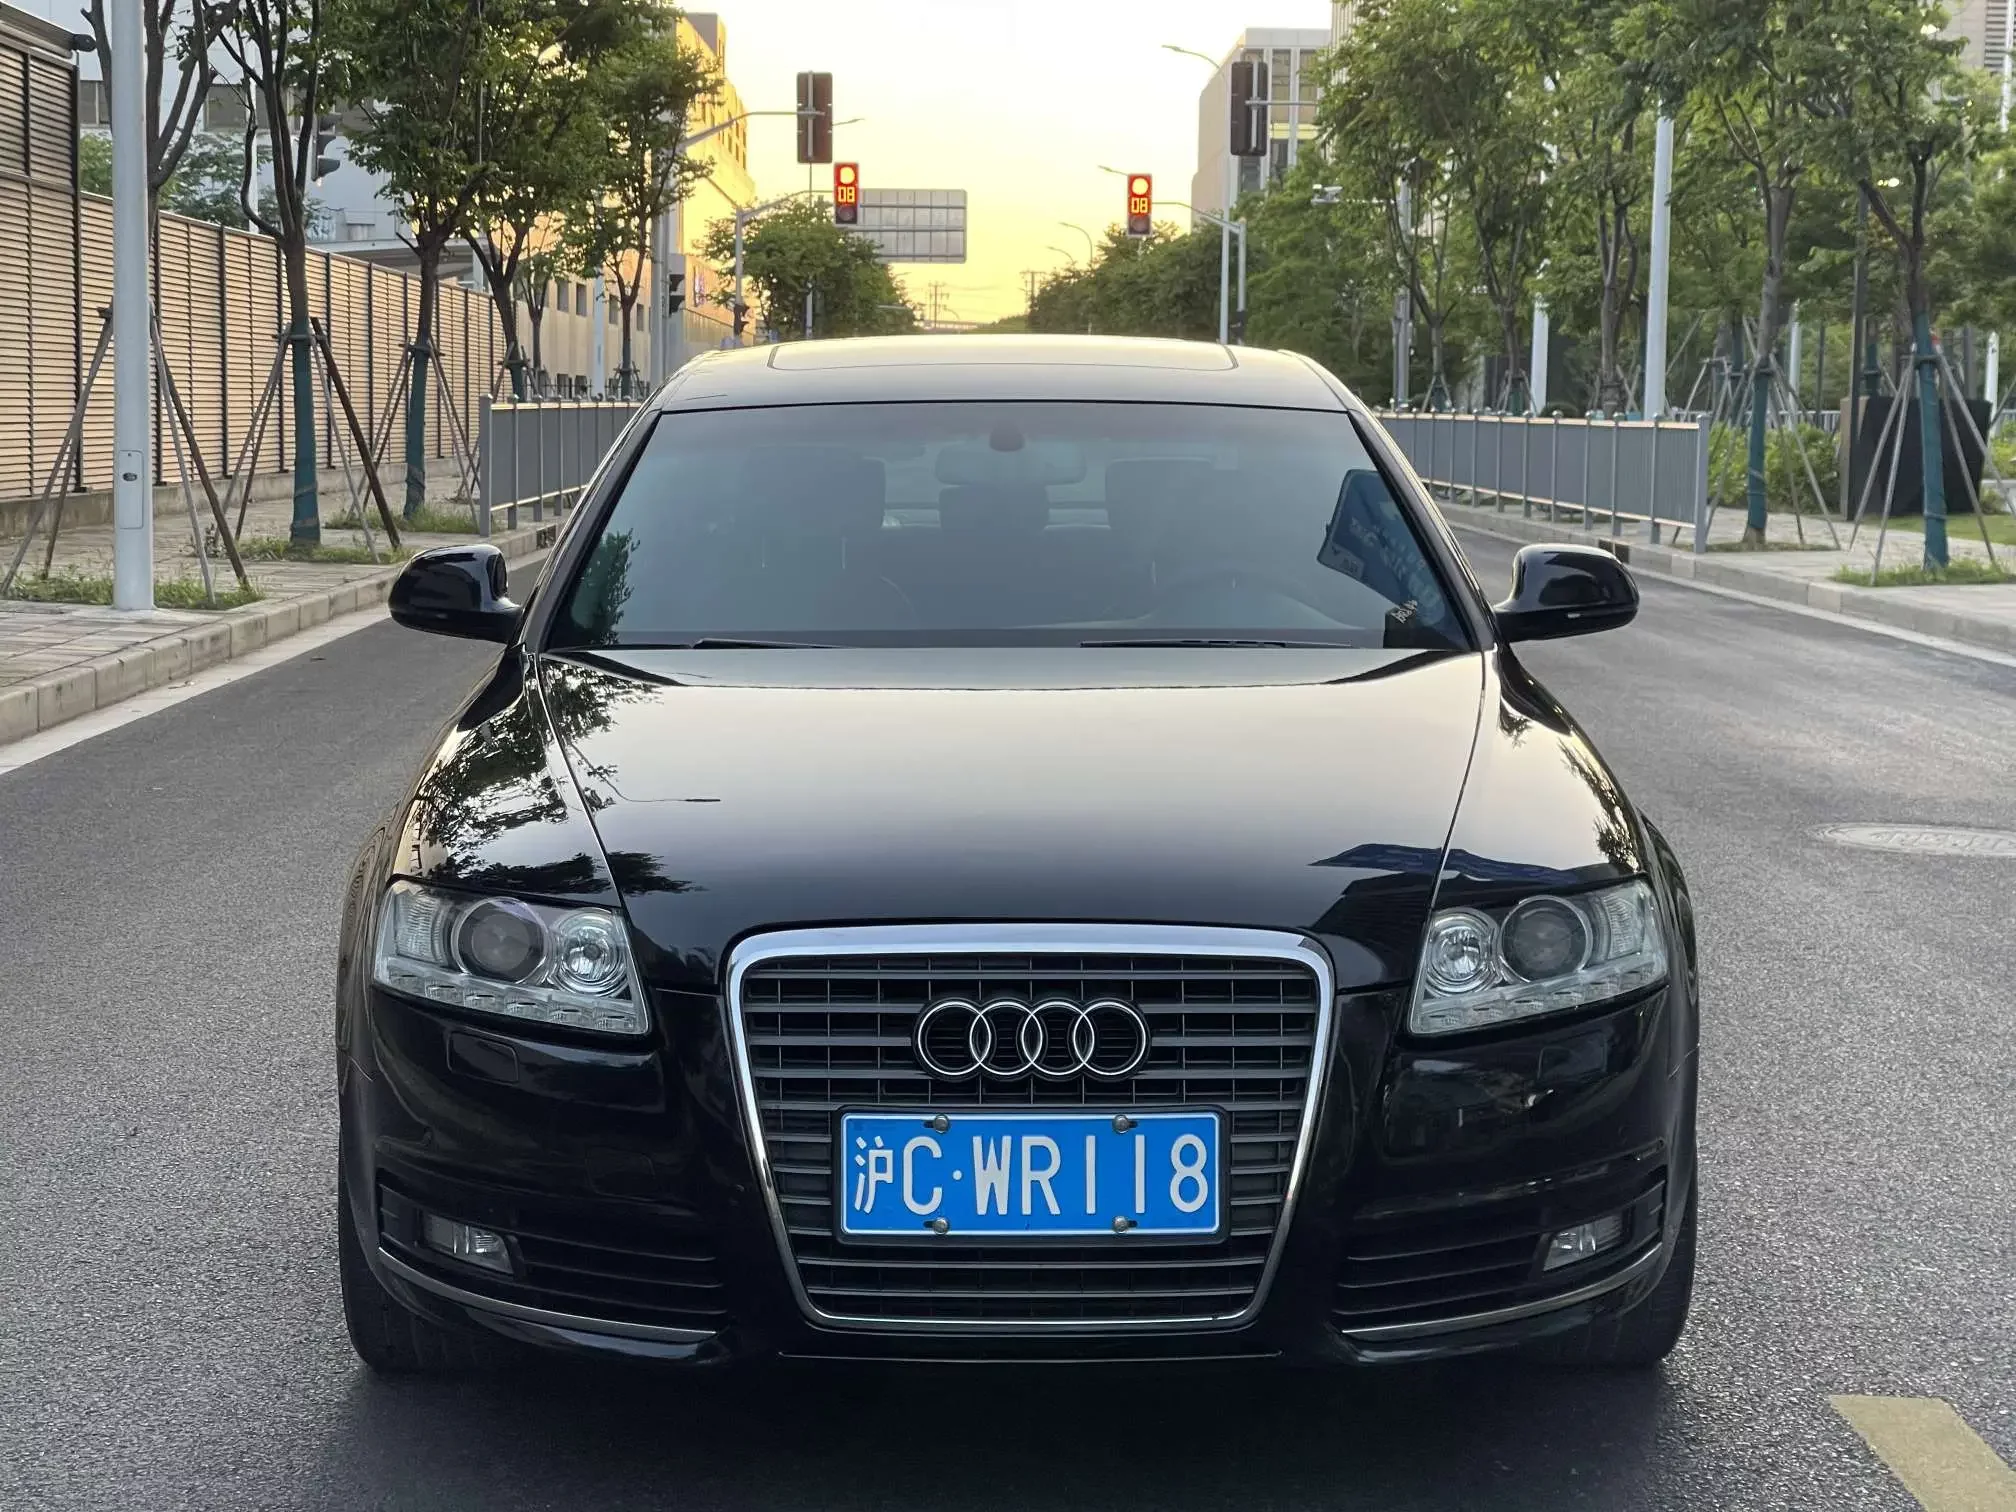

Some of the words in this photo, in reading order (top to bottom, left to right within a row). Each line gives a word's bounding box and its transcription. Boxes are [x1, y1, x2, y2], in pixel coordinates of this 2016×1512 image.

[838, 186, 855, 203] 08
[1131, 197, 1148, 213] 08
[853, 1133, 1209, 1216] 沪C·WR118
